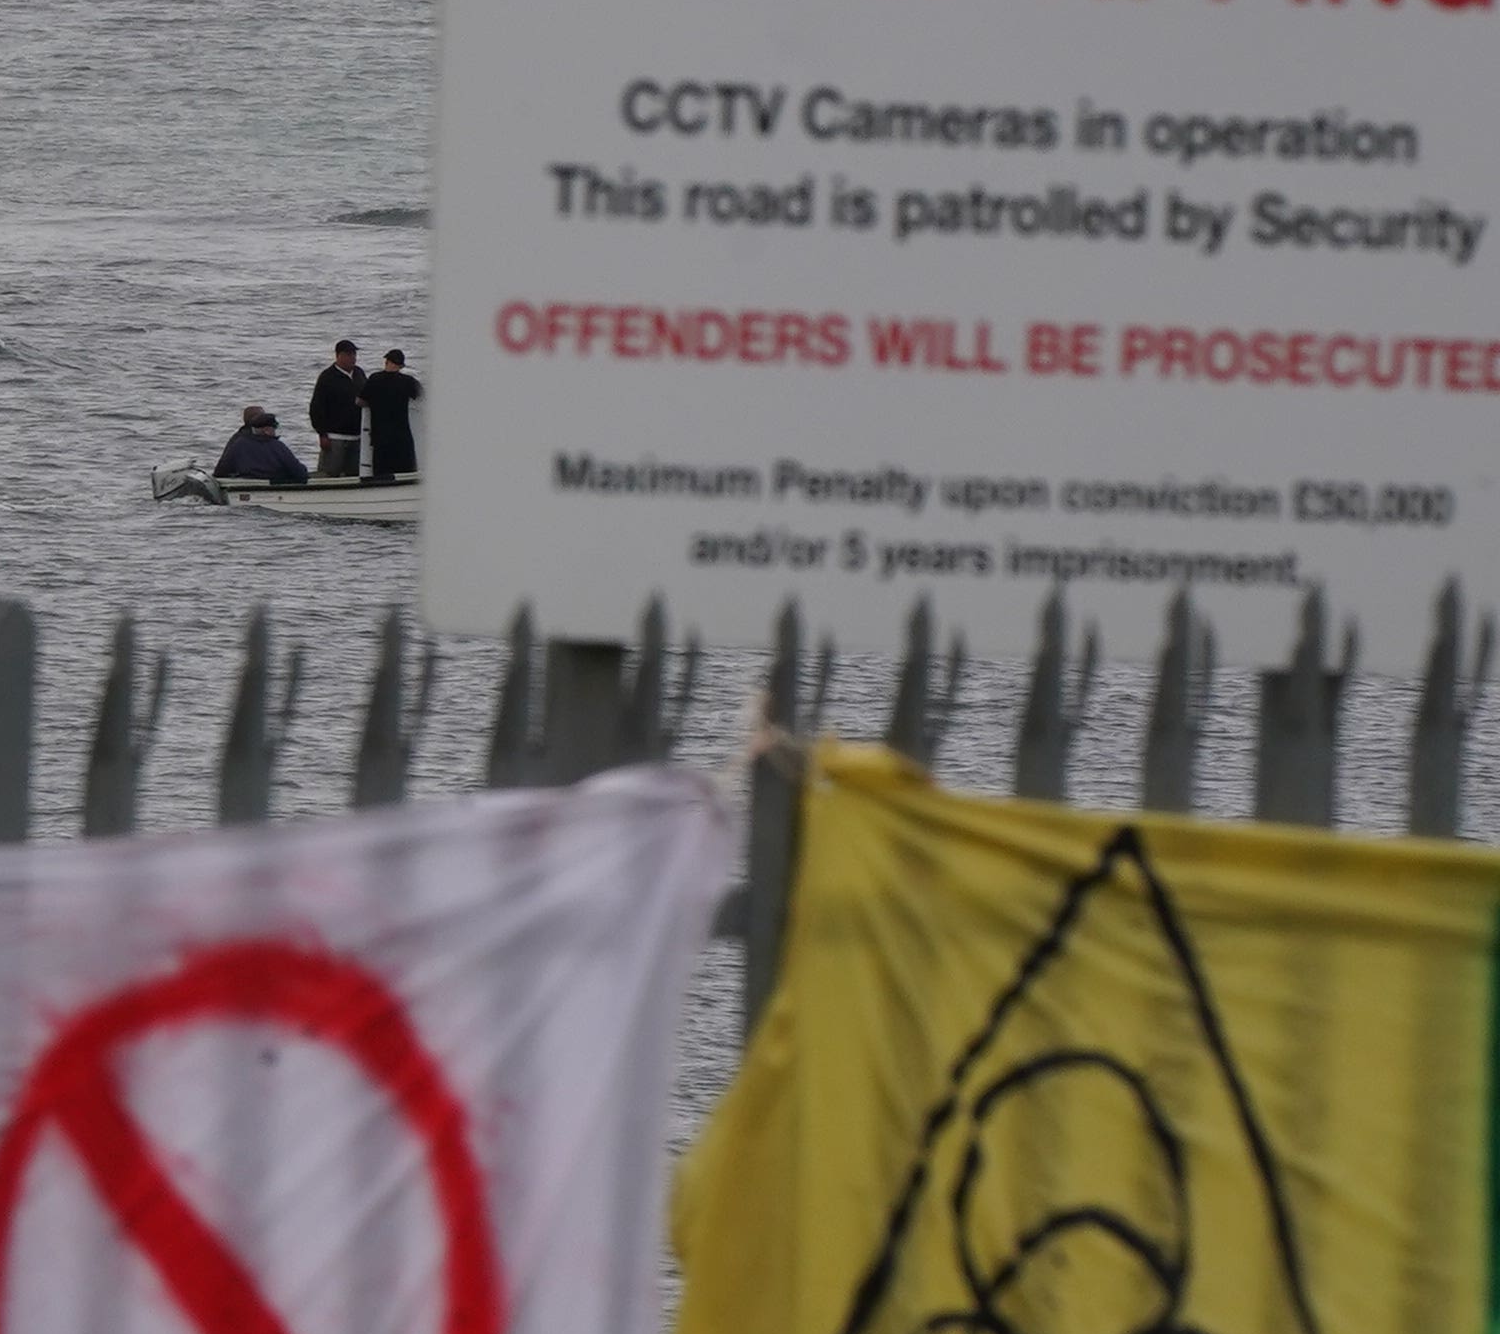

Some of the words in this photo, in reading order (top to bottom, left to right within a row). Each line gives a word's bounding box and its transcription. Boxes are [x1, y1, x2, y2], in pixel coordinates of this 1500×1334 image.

[620, 79, 788, 139] CCTV
[800, 85, 1060, 151] Cameras
[1075, 95, 1128, 151] in
[1143, 107, 1420, 167] operation
[548, 163, 667, 223] This
[682, 175, 814, 229] road
[828, 177, 878, 229] is
[895, 183, 1150, 243] patrolled
[1163, 189, 1234, 257] by
[1248, 193, 1488, 267] Security
[496, 301, 851, 369] OFFENDERS
[870, 317, 1006, 375] WILL
[1025, 321, 1102, 377] BE
[552, 451, 762, 503] Maximum
[773, 461, 928, 515] Penalty
[943, 475, 1050, 519] upon
[1060, 477, 1284, 523] conviction
[690, 533, 831, 573] and/or
[842, 535, 868, 573] 5
[876, 543, 992, 581] years
